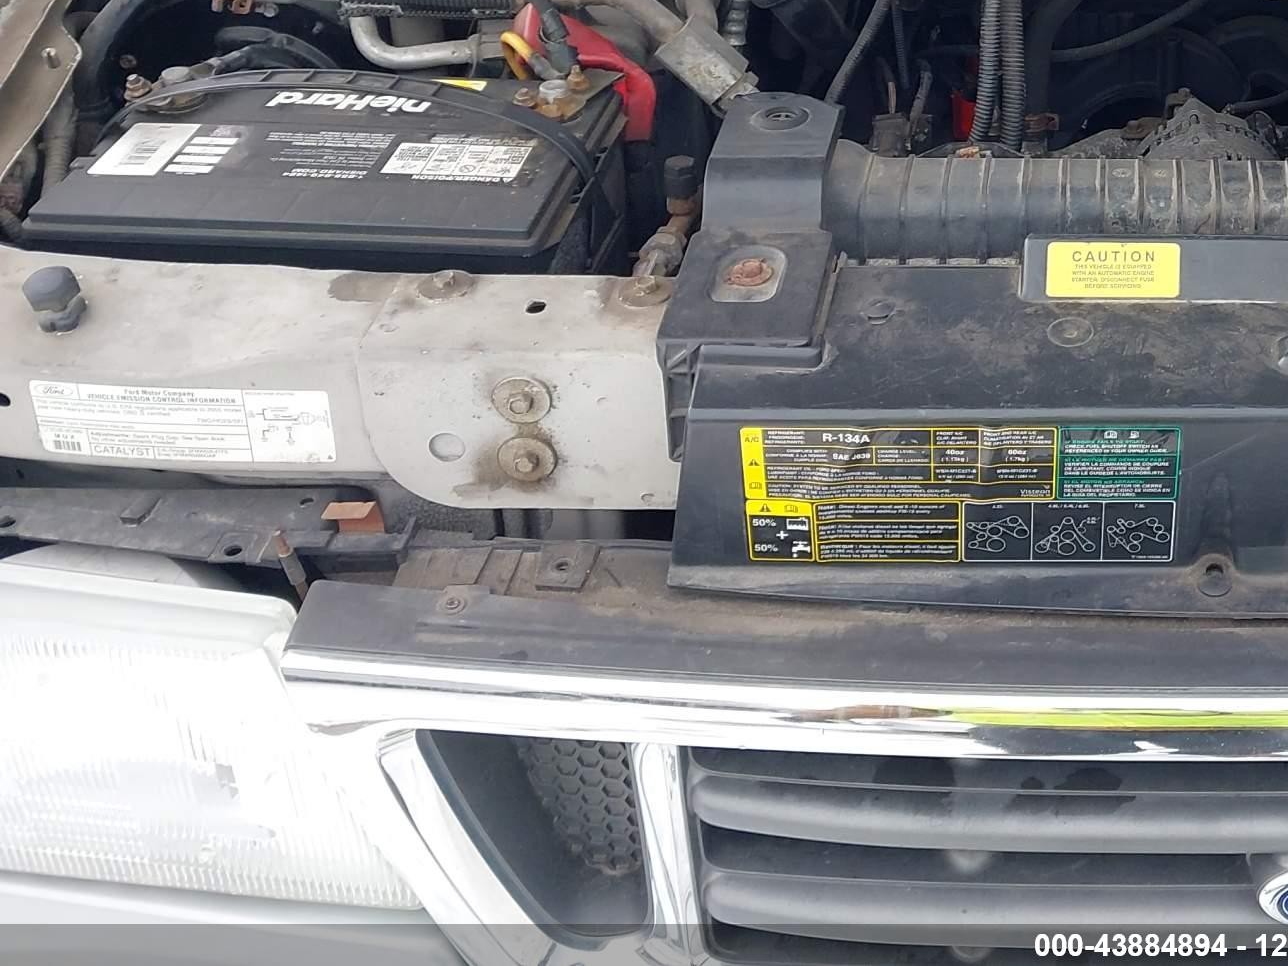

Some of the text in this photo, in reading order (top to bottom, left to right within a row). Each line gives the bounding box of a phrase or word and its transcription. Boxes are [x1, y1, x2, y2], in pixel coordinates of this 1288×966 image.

[1072, 250, 1155, 262] CAUTION
[822, 432, 870, 444] R-134A
[94, 445, 150, 457] CATALYST
[832, 453, 849, 461] SAE
[752, 519, 777, 528] 50%
[754, 544, 779, 553] 50%
